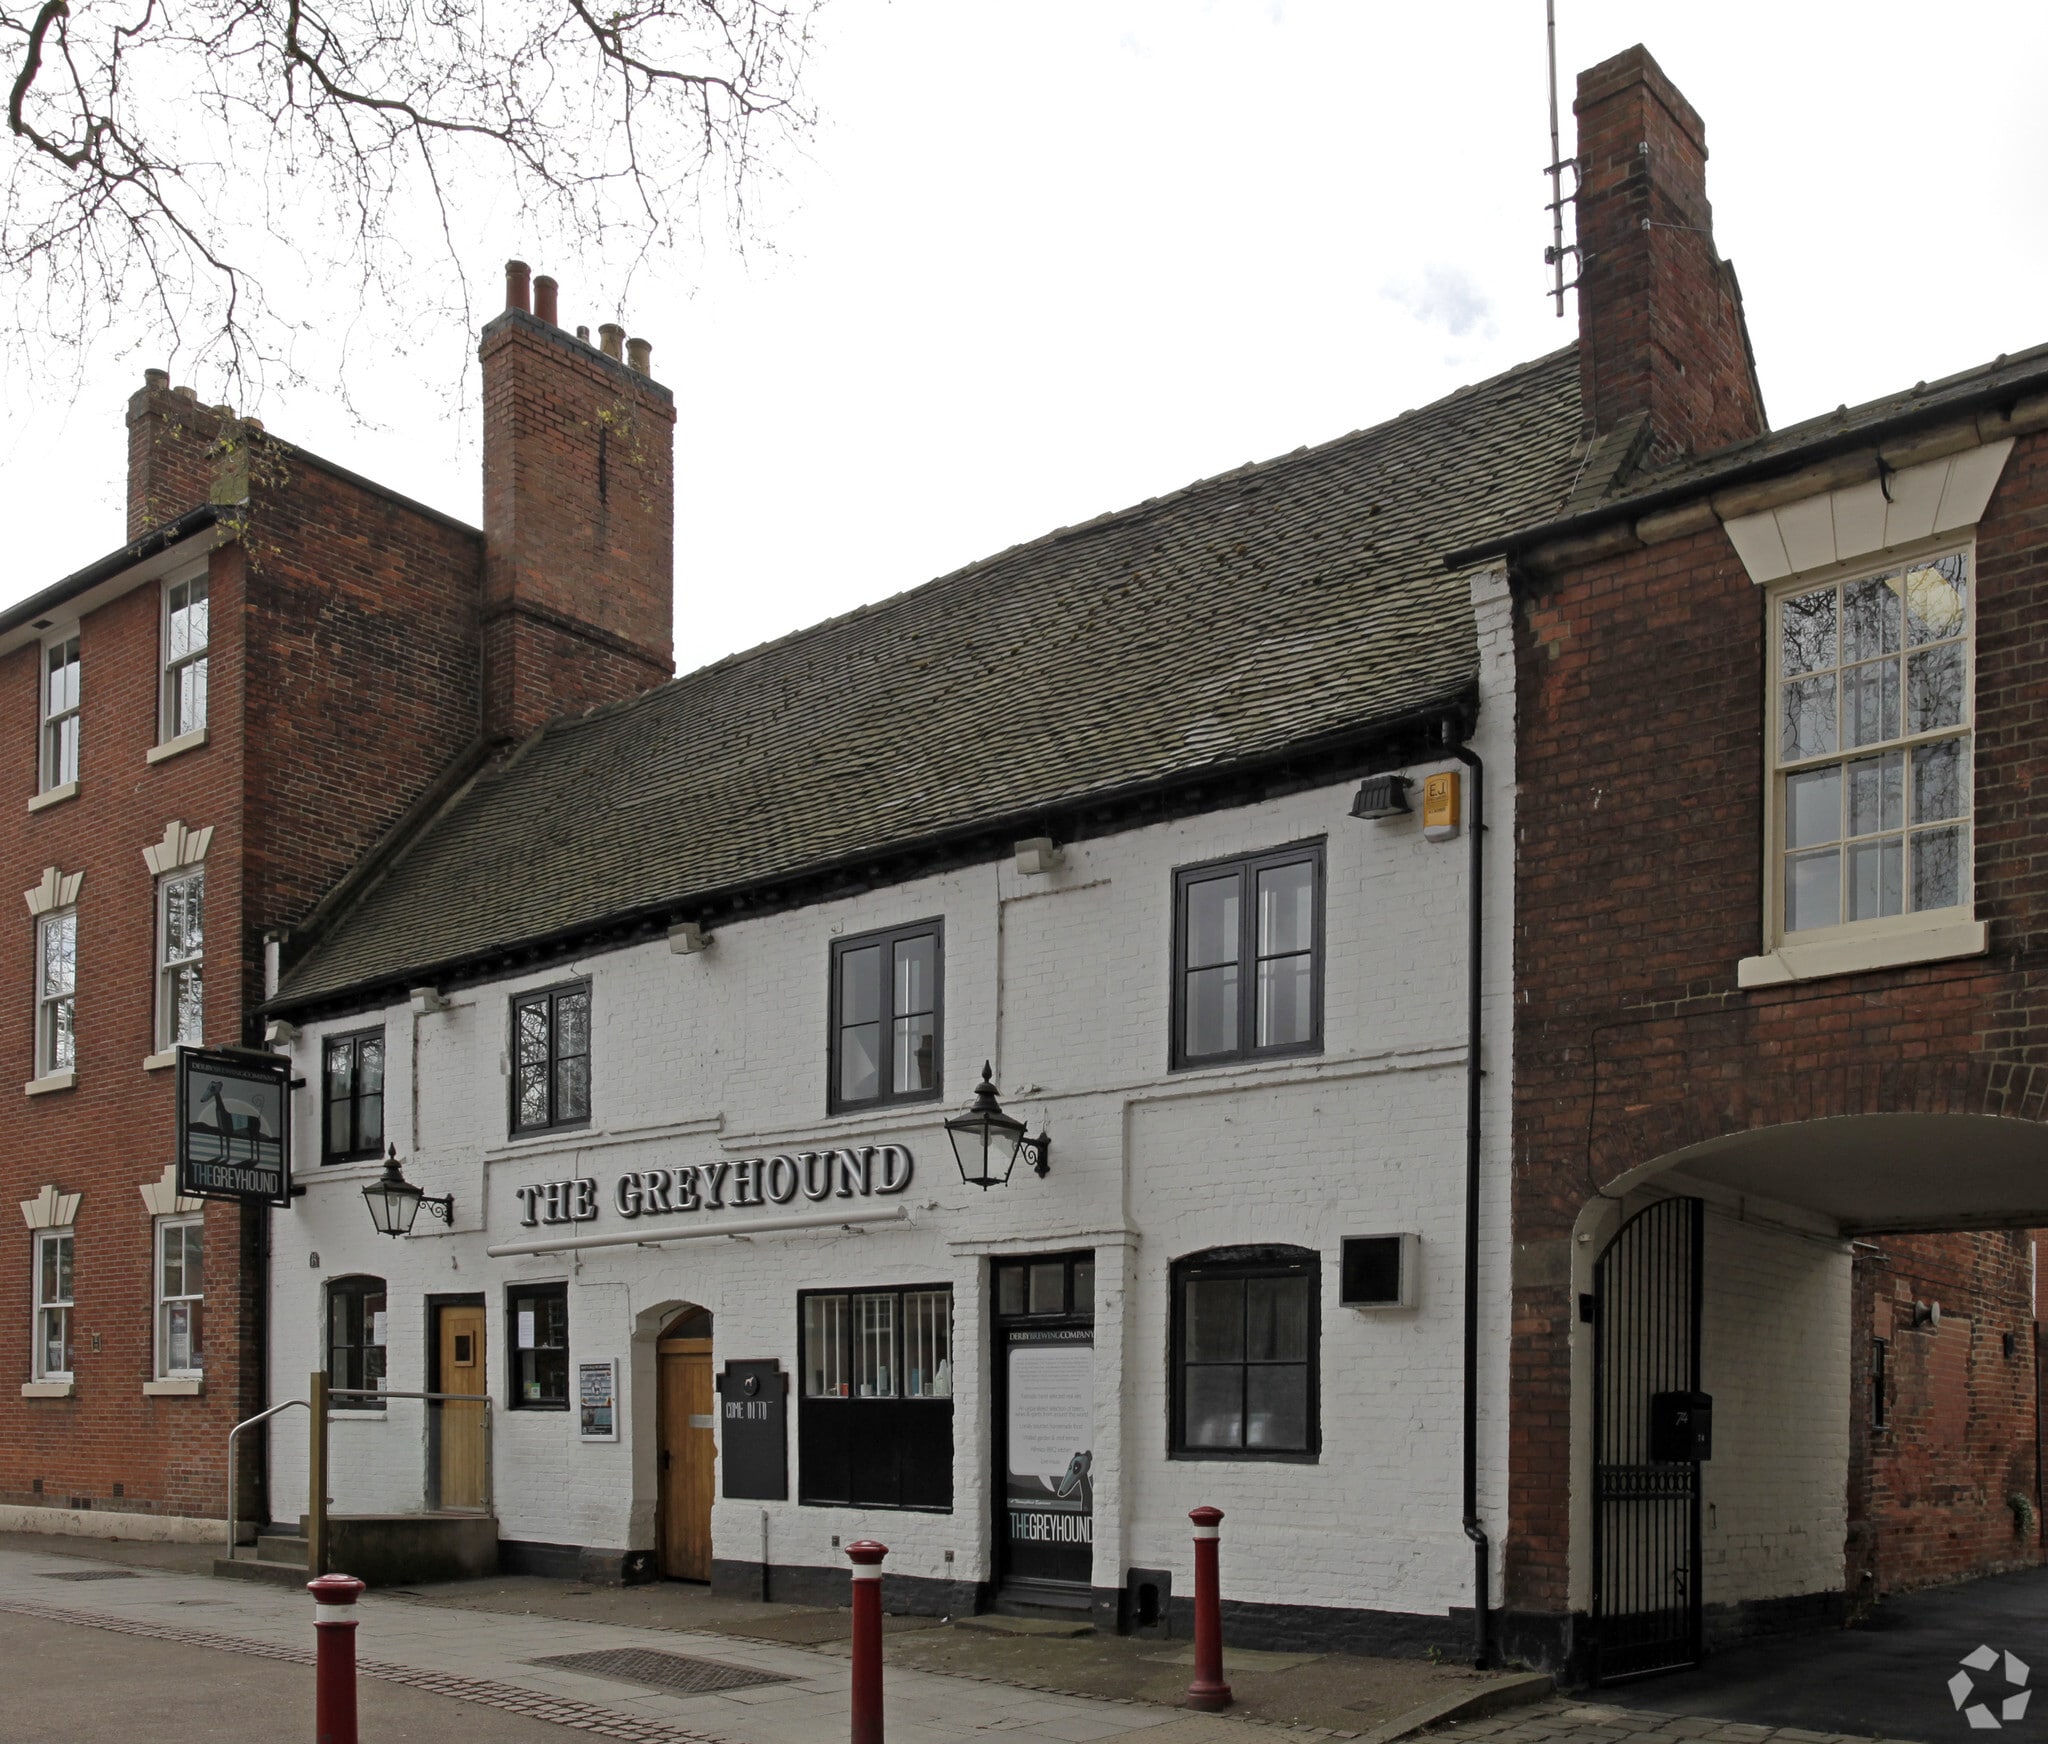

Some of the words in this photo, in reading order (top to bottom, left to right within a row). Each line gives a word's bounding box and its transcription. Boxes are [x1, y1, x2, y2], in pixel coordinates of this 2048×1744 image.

[517, 1177, 598, 1227] THE
[614, 1143, 914, 1219] GREYHOUND
[726, 1401, 744, 1419] COME
